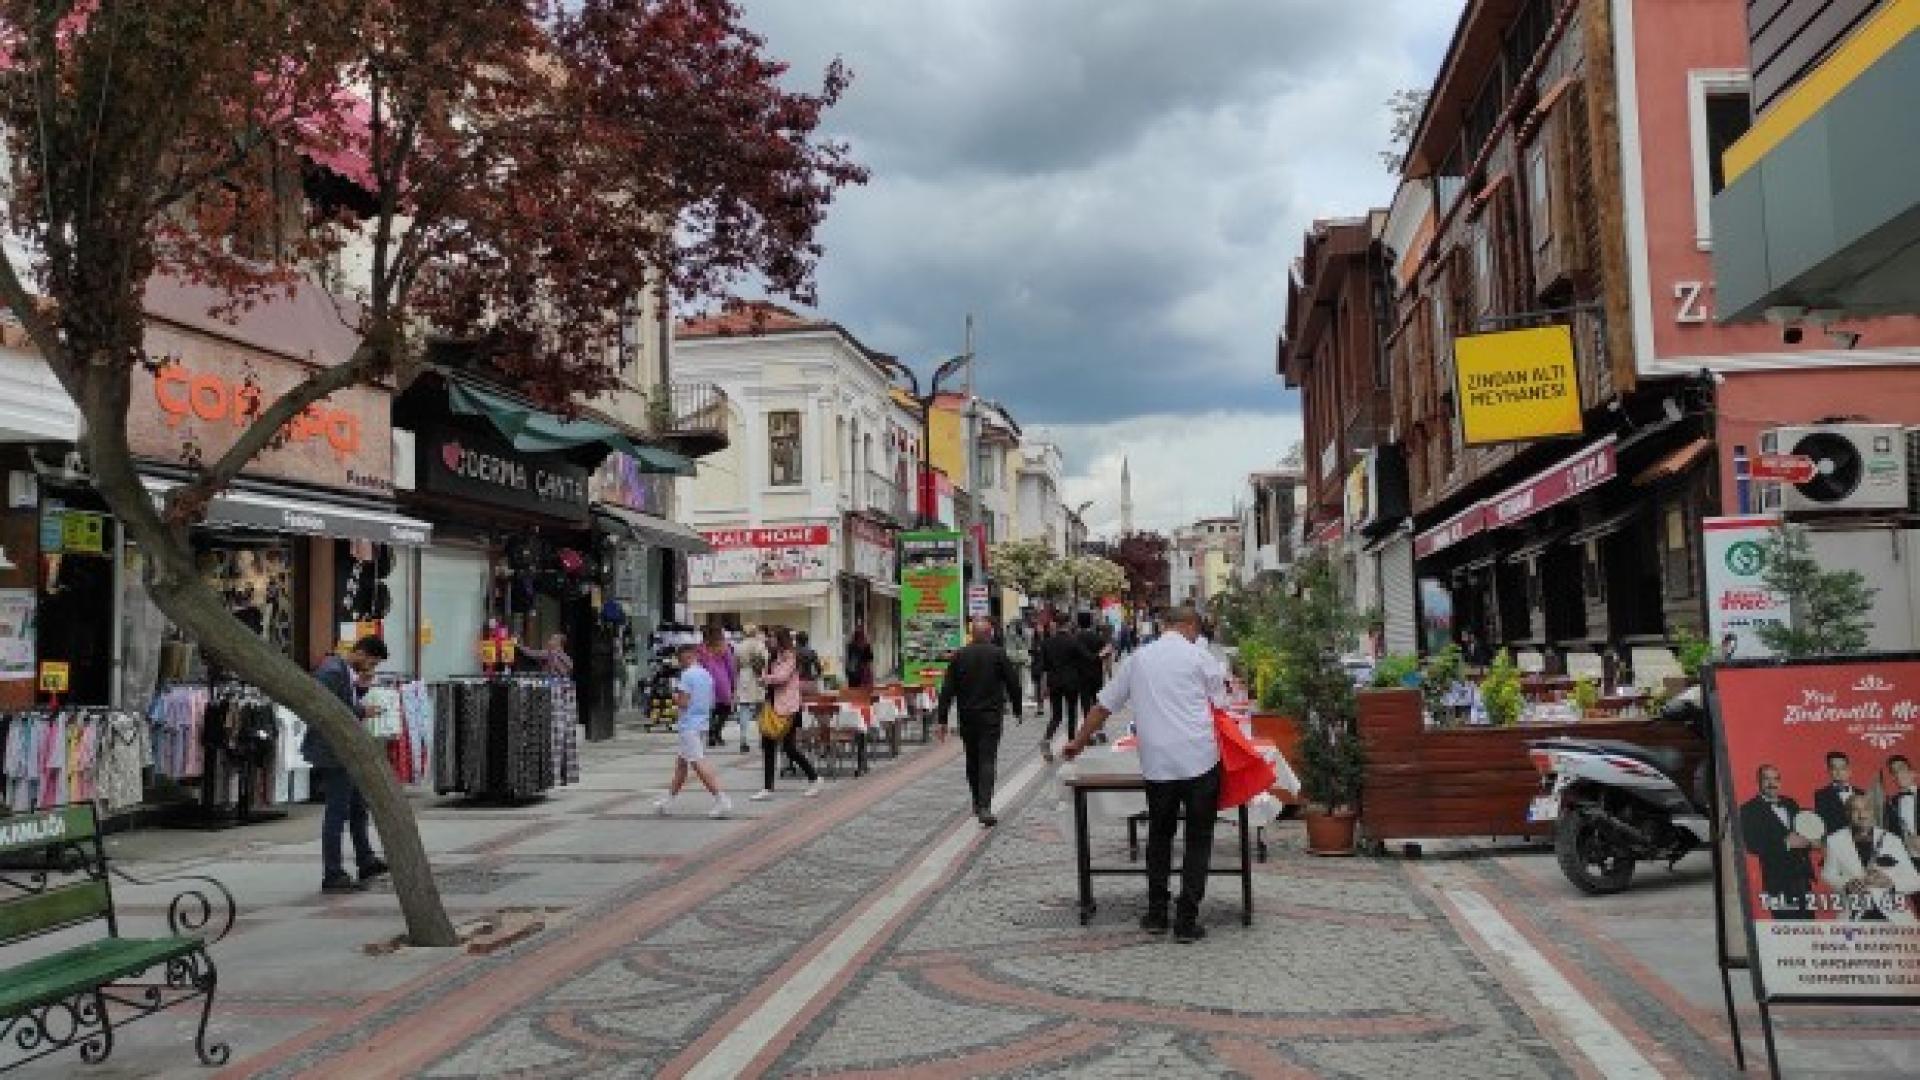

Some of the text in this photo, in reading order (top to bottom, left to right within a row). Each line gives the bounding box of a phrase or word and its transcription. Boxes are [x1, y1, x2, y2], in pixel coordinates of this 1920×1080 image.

[1674, 281, 1717, 323] Z
[760, 528, 813, 544] HOME
[1805, 893, 1843, 911] 212
